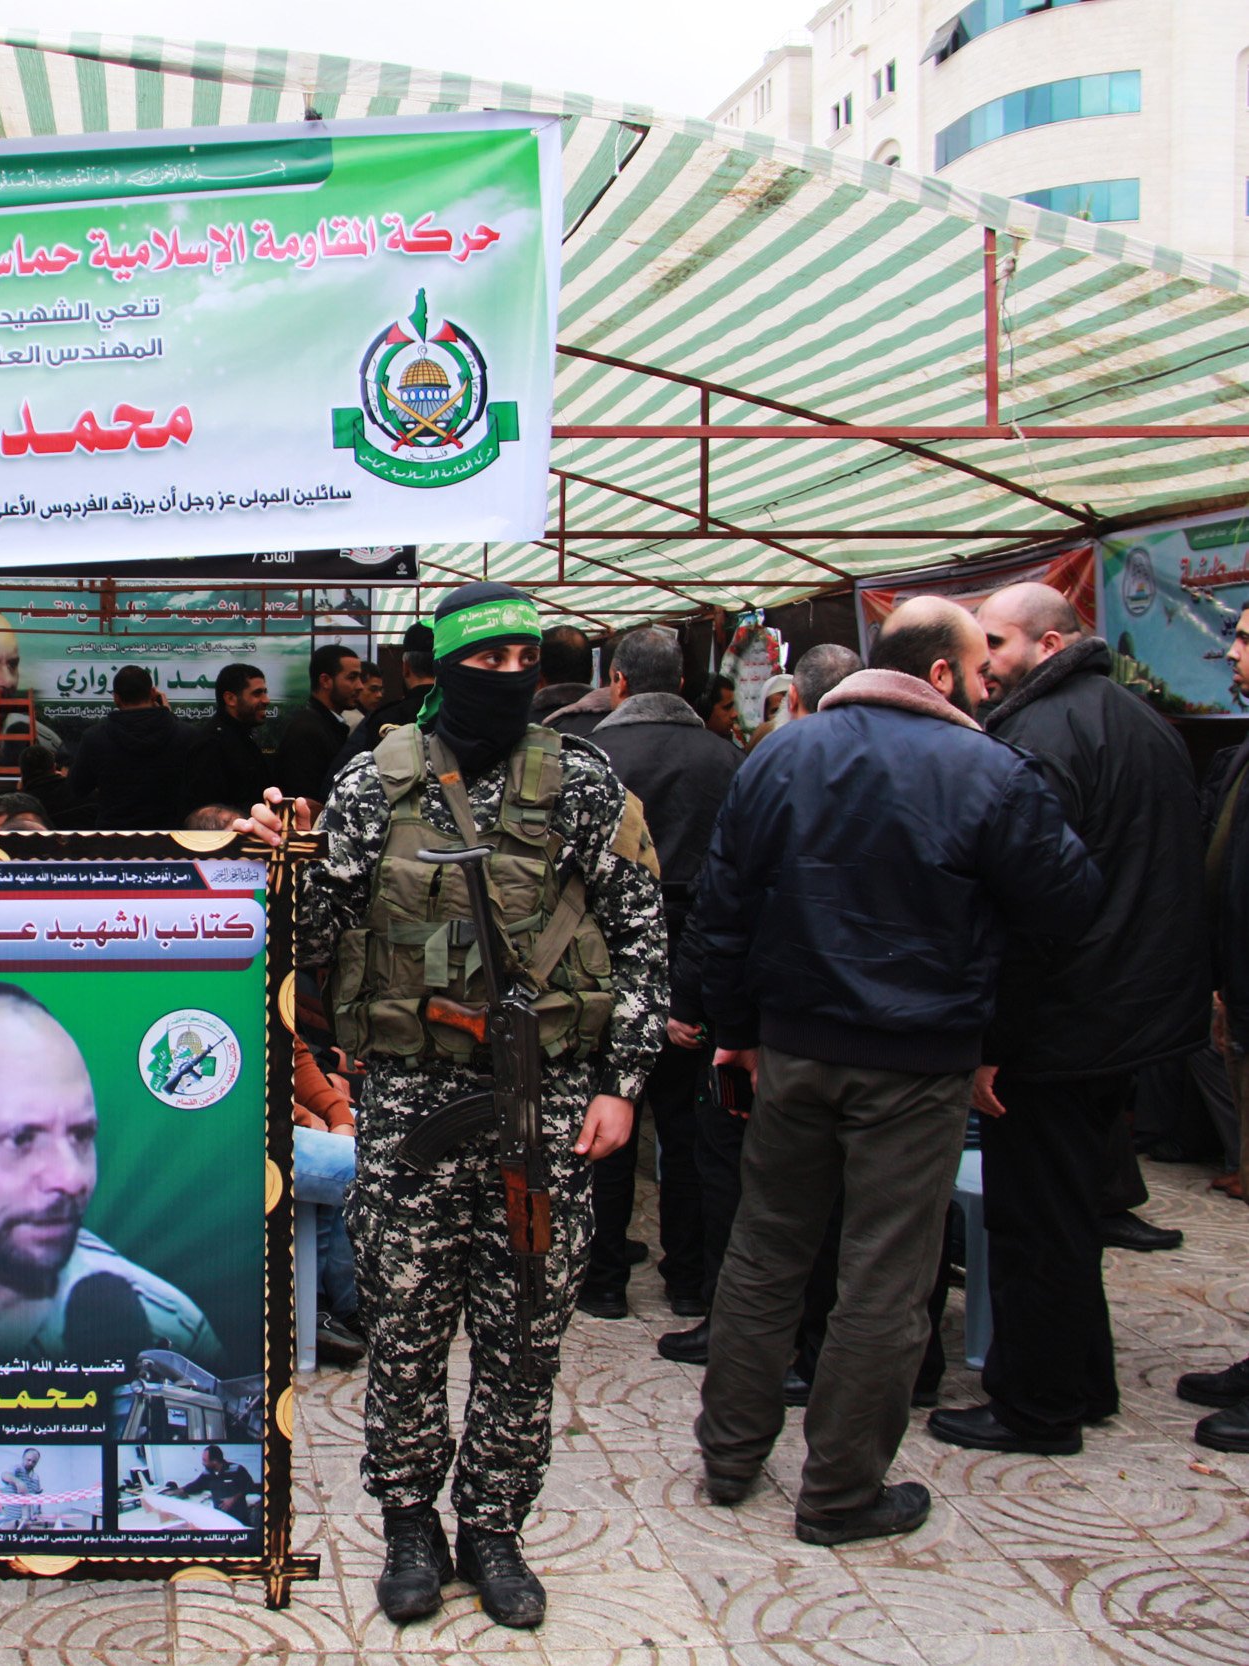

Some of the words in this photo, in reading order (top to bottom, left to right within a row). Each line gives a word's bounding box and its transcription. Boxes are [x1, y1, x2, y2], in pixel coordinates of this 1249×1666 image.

[254, 218, 376, 269] المقاومة
[384, 213, 501, 261] حركة
[87, 224, 246, 281] الإسلامية
[0, 303, 89, 327] الشهيد
[96, 300, 161, 323] تنعي
[46, 338, 163, 364] المهندس
[0, 400, 194, 454] محمد
[111, 491, 157, 516] يرزقه
[159, 487, 177, 512] أن
[181, 491, 215, 512] وجل
[219, 490, 236, 510] عز
[239, 487, 290, 508] المولى
[293, 486, 352, 506] سائلين
[41, 493, 108, 520] الفردوس
[44, 908, 148, 950] الشهيد
[154, 911, 256, 950] كتائب
[32, 1357, 52, 1372] الله
[55, 1359, 78, 1372] عند
[2, 1421, 31, 1435] أشرفوا
[33, 1423, 59, 1435] الذين
[61, 1423, 88, 1433] القادة
[90, 1421, 106, 1433] أحد
[19, 1534, 49, 1545] الموافق
[50, 1534, 82, 1544] الخميس
[83, 1536, 99, 1545] يوم
[100, 1533, 127, 1544] الجبانة
[128, 1534, 169, 1544] الصهيونية
[170, 1534, 191, 1544] الغدر
[230, 1533, 248, 1545] الذي
